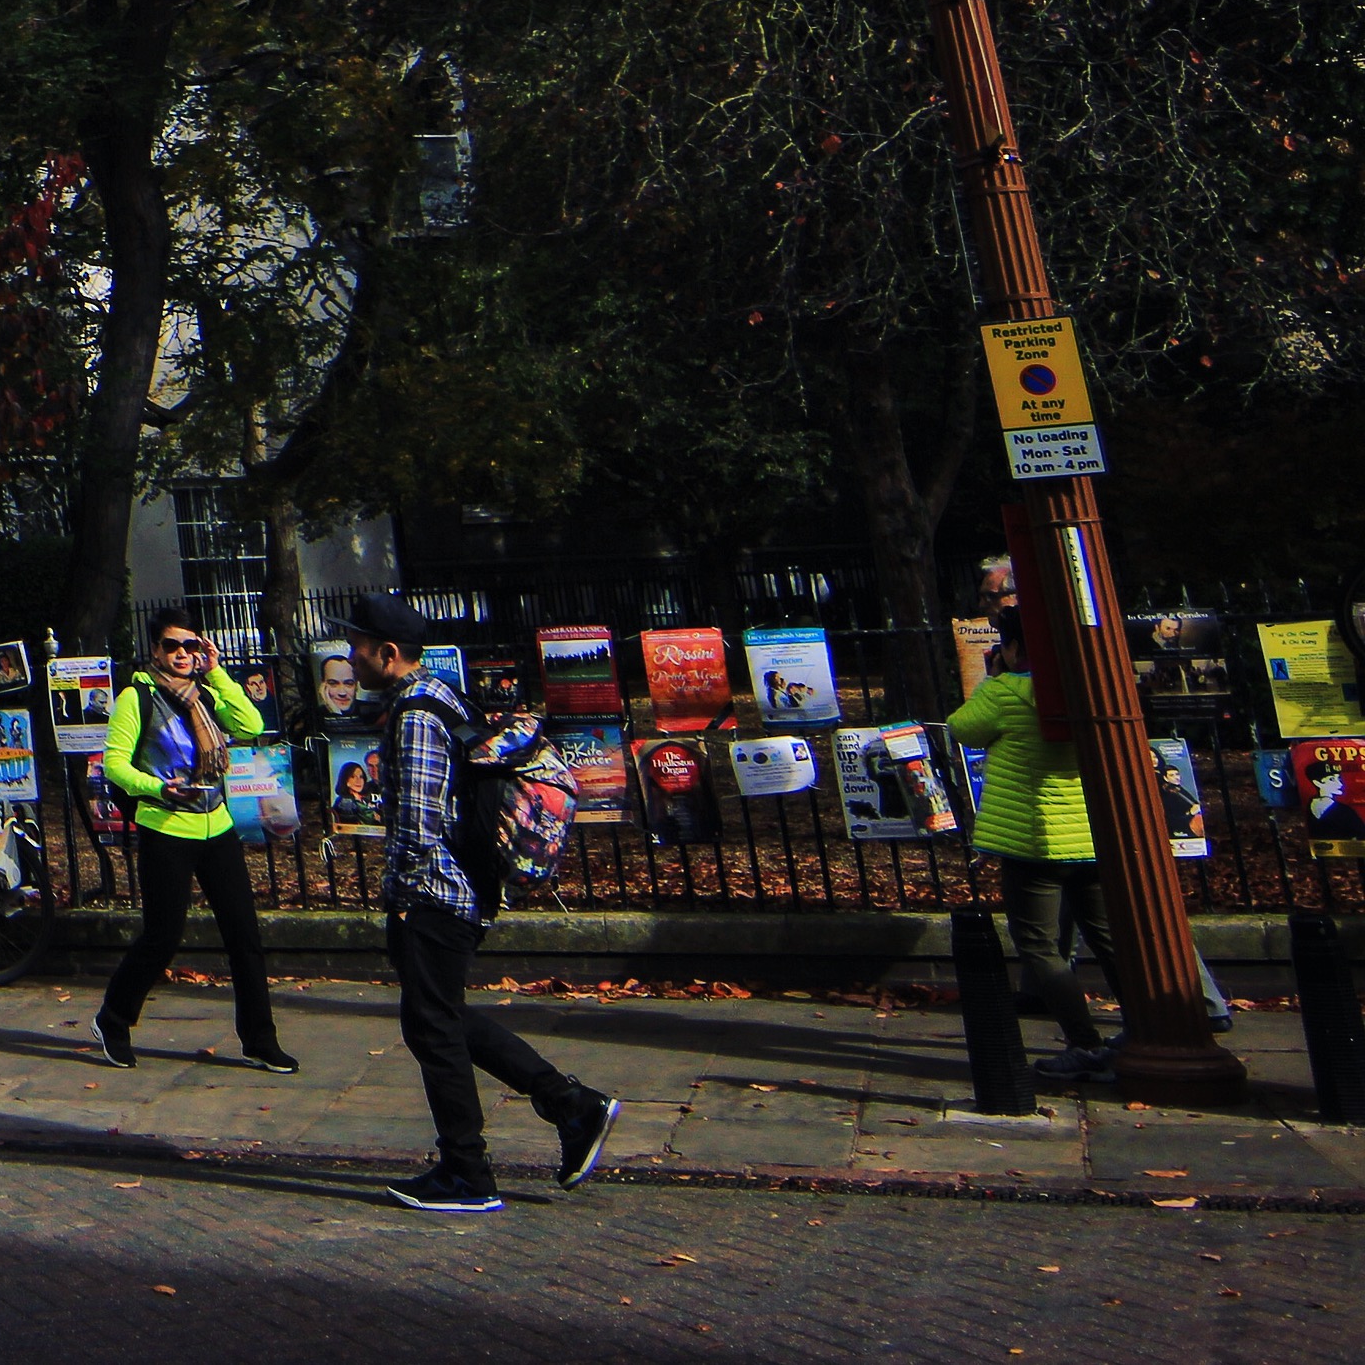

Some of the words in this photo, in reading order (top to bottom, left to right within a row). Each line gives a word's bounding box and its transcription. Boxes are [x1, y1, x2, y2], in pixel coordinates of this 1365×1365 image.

[992, 322, 1062, 338] Restricted
[1004, 337, 1055, 349] Parking
[1015, 350, 1049, 360] Zone
[1021, 400, 1036, 411] At
[1042, 399, 1065, 410] any
[1031, 411, 1061, 422] time
[1013, 434, 1033, 445] No
[1038, 430, 1088, 443] loading
[1022, 448, 1052, 460] Mon
[1062, 445, 1087, 456] Sat
[1014, 462, 1031, 474] 10
[1034, 461, 1054, 472] am
[1065, 459, 1075, 470] 4
[1077, 459, 1099, 471] pm
[653, 644, 715, 666] Rossini
[434, 656, 459, 673] PEOPLE
[837, 732, 860, 742] can't
[573, 740, 604, 757] Kite
[837, 741, 860, 750] stand
[561, 747, 613, 769] Runner
[663, 751, 681, 761] The
[837, 750, 858, 764] up
[661, 766, 688, 776] Organ
[840, 763, 859, 773] for
[229, 784, 252, 793] DRAMA
[252, 782, 274, 792] GROUP
[844, 782, 875, 794] down
